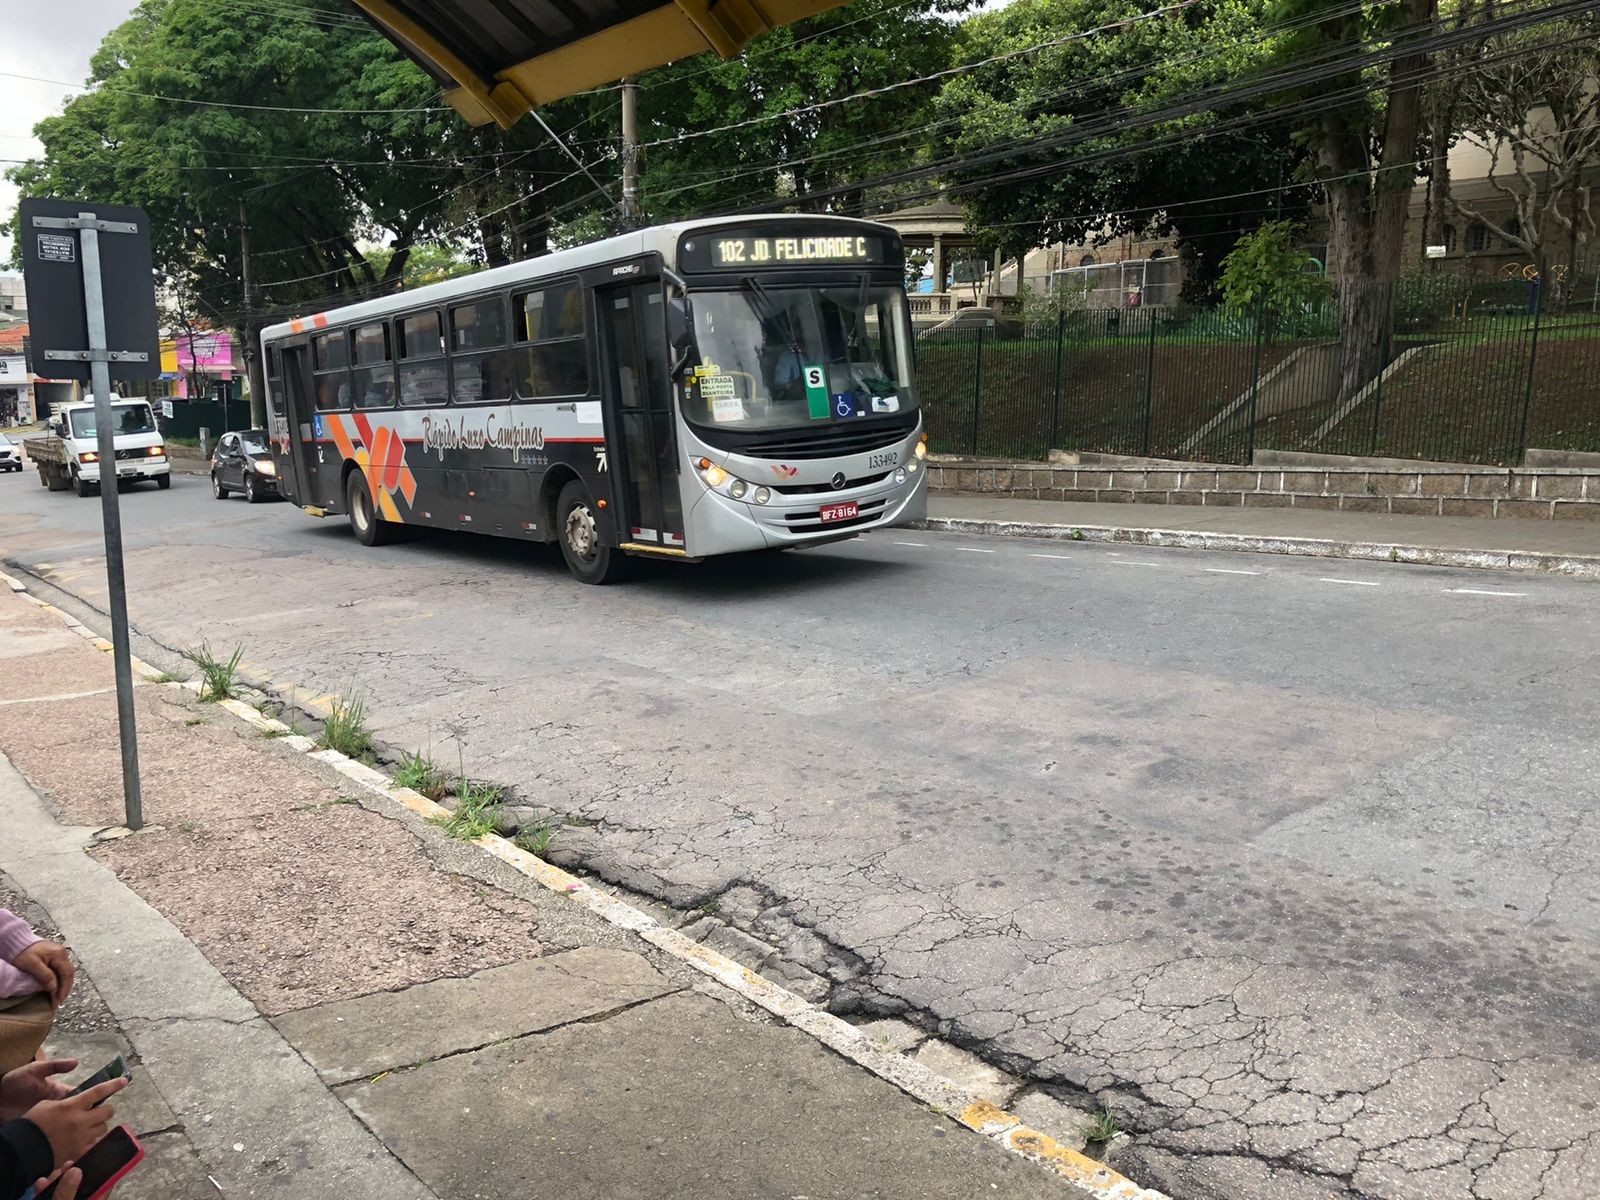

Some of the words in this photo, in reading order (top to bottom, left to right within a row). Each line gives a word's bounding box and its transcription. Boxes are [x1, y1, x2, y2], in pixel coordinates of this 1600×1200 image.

[718, 240, 746, 262] 102
[775, 237, 853, 260] FELICIDADE
[856, 236, 867, 257] C
[809, 370, 820, 384] S
[422, 416, 457, 461] Rápido
[458, 415, 485, 450] Luxo
[486, 413, 545, 463] Campinas
[868, 452, 898, 469] 133492
